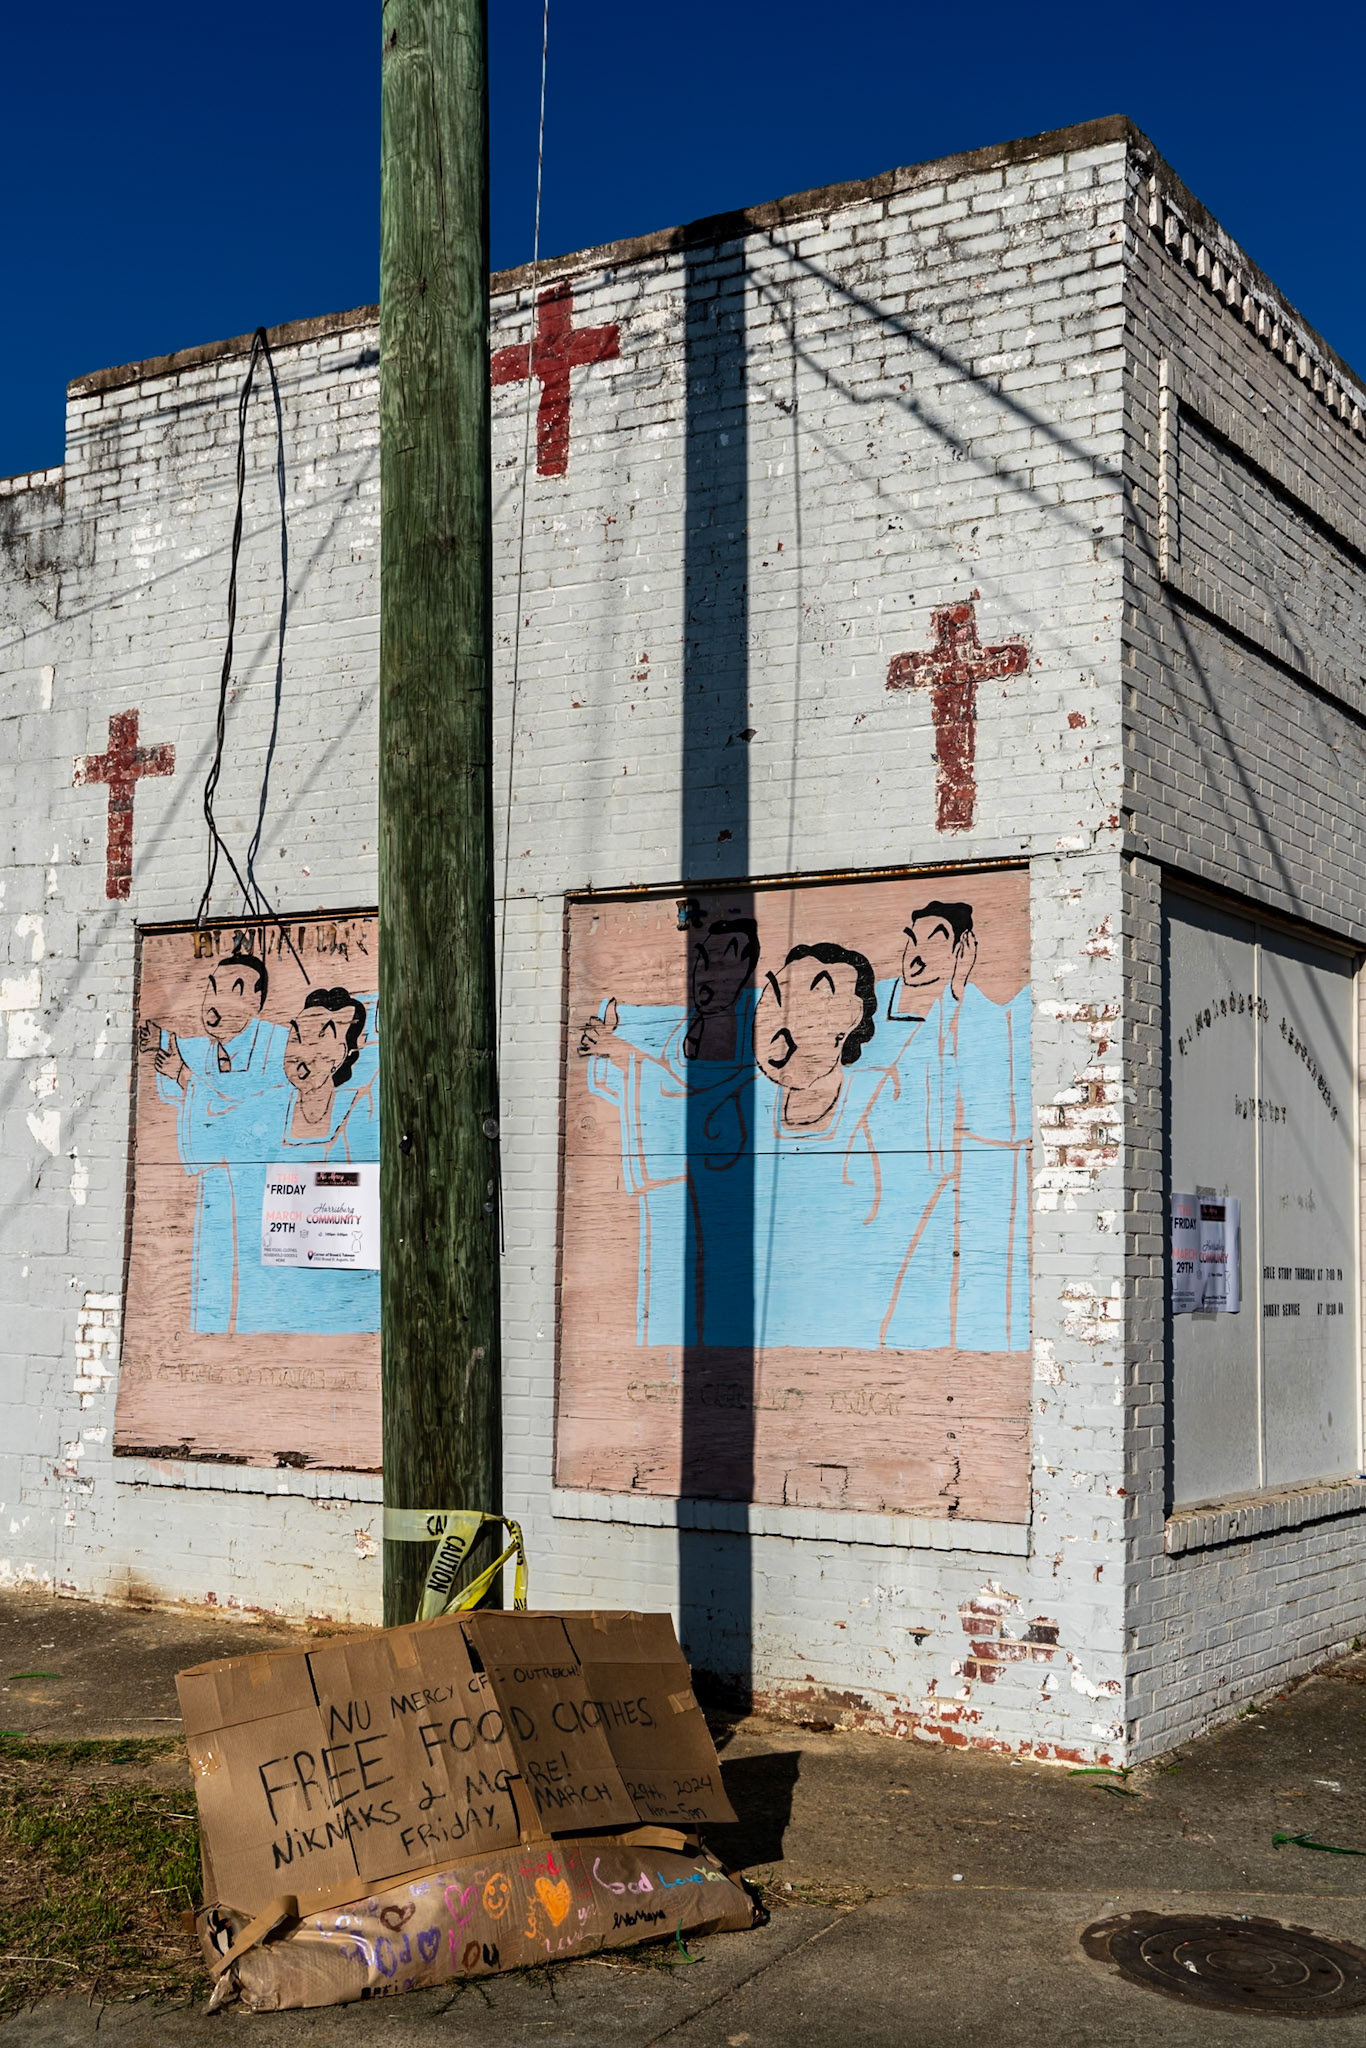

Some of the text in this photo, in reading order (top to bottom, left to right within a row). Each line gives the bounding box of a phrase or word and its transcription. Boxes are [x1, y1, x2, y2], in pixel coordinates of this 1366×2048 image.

[276, 1173, 299, 1184] THIS
[270, 1184, 306, 1195] FRIDAY
[313, 1202, 355, 1214] Harrisburg
[265, 1210, 302, 1221] MARCH
[306, 1214, 362, 1225] COMMUNITY
[270, 1222, 296, 1233] 29TH
[1174, 1217, 1197, 1230] FRIDAY
[1172, 1248, 1197, 1260] MARCH
[1176, 1262, 1193, 1274] 29TH
[1278, 1267, 1292, 1280] STUDY
[1294, 1267, 1316, 1281] THURSDAY
[1263, 1303, 1280, 1317] SUNDAY
[1282, 1303, 1300, 1316] SERVICE
[1317, 1303, 1323, 1316] AT
[426, 1535, 466, 1595] CAUTION
[329, 1700, 372, 1741] NU
[389, 1685, 455, 1719] MERCY
[258, 1733, 395, 1826] FREE
[418, 1705, 540, 1767] FOOD,
[465, 1750, 573, 1804] MORE!
[533, 1781, 613, 1814] MARCH
[672, 1773, 714, 1797] 2024
[592, 1856, 654, 1895] God
[656, 1871, 705, 1888] Love
